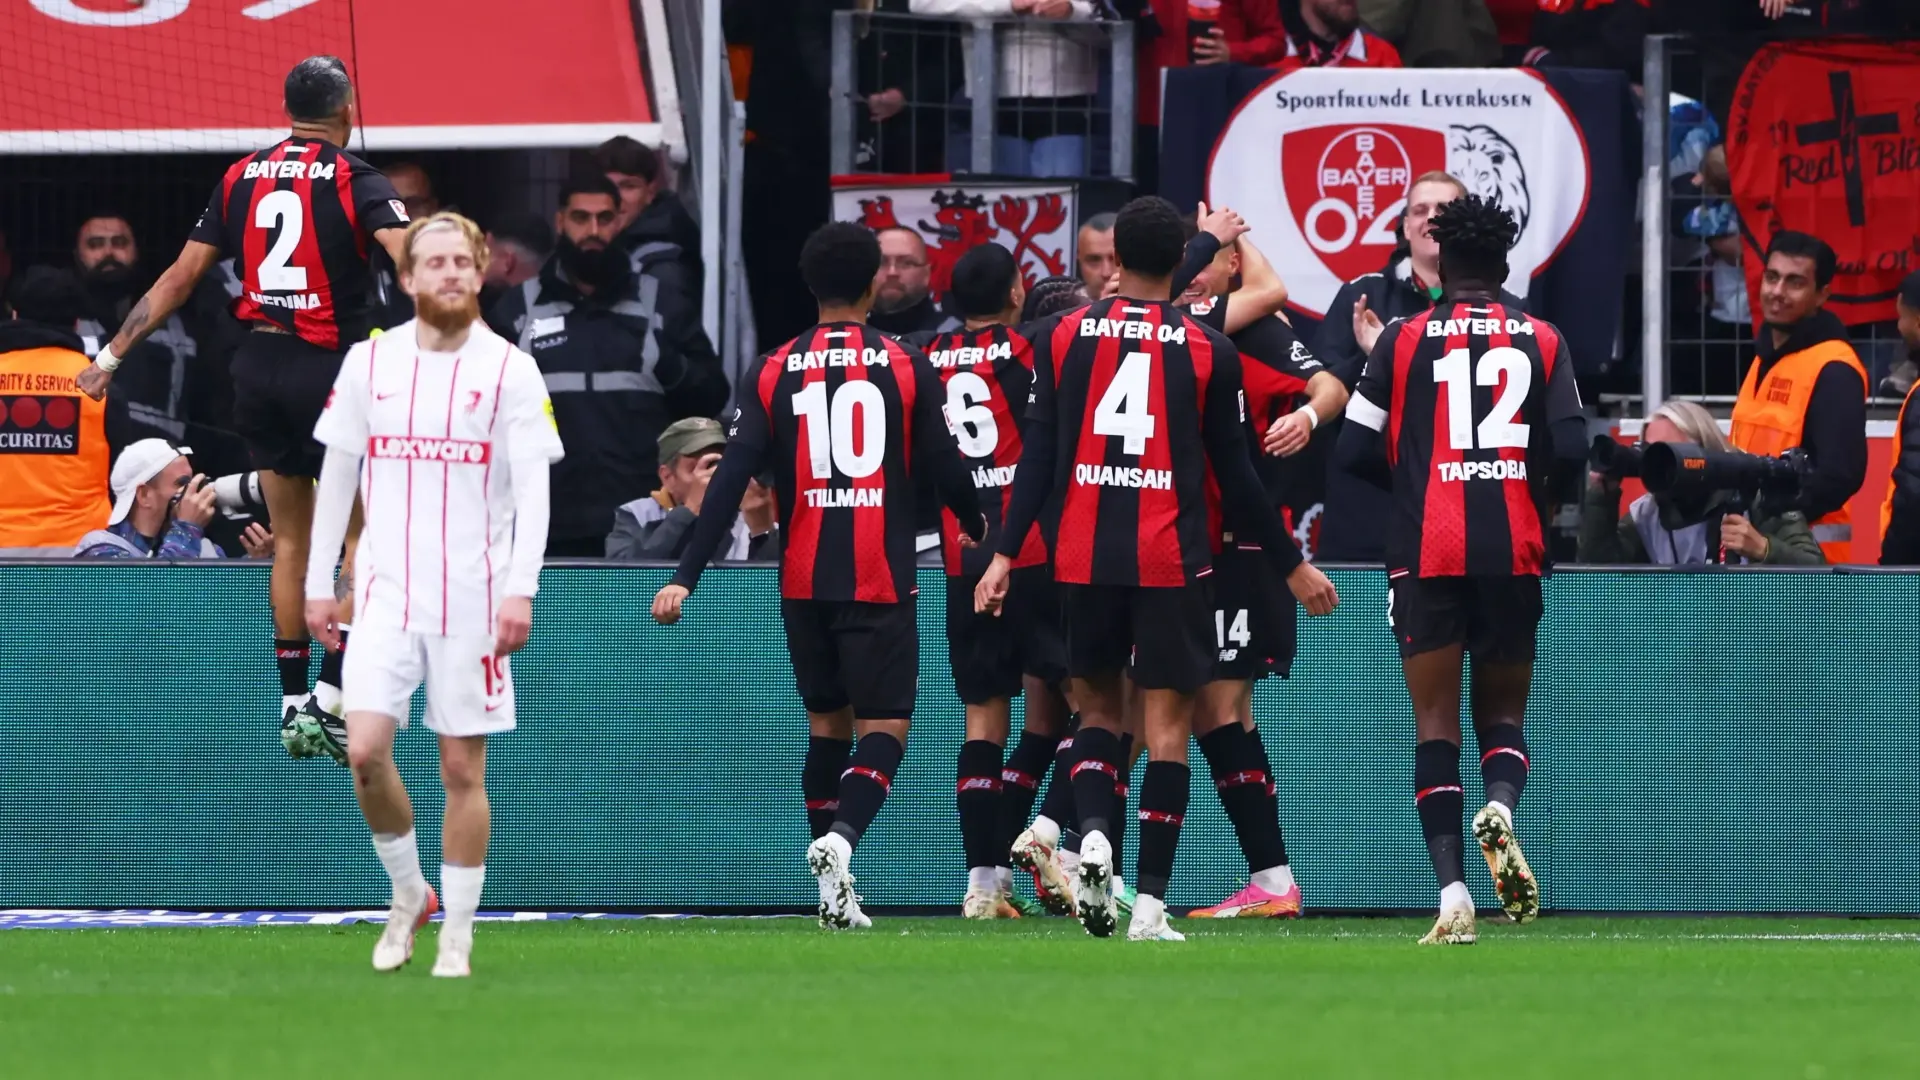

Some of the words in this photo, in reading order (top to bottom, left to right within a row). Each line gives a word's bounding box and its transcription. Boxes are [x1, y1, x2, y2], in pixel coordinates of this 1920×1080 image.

[244, 160, 306, 180] BAYER
[308, 163, 335, 180] 04
[1322, 168, 1407, 185] BAYER
[1356, 134, 1375, 219] BAYER
[1780, 145, 1839, 188] Red
[255, 190, 307, 291] 2
[249, 291, 321, 310] MEDINA
[1080, 318, 1154, 340] BAYER
[1157, 324, 1186, 345] 04
[1427, 318, 1501, 337] BAYER
[1505, 321, 1534, 335] 04
[787, 349, 857, 372] BAYER
[861, 348, 889, 367] 04
[929, 347, 985, 368] BAYER
[986, 342, 1012, 361] 04
[25, 374, 33, 390] &
[1093, 351, 1155, 455] 4
[1433, 347, 1532, 449] 12
[946, 372, 998, 458] 6
[791, 379, 886, 479] 10
[1076, 463, 1173, 490] QUANSAH
[1438, 460, 1527, 482] TAPSOBA
[804, 488, 883, 508] TILLMAN
[1215, 608, 1251, 648] 14
[481, 654, 505, 696] 19
